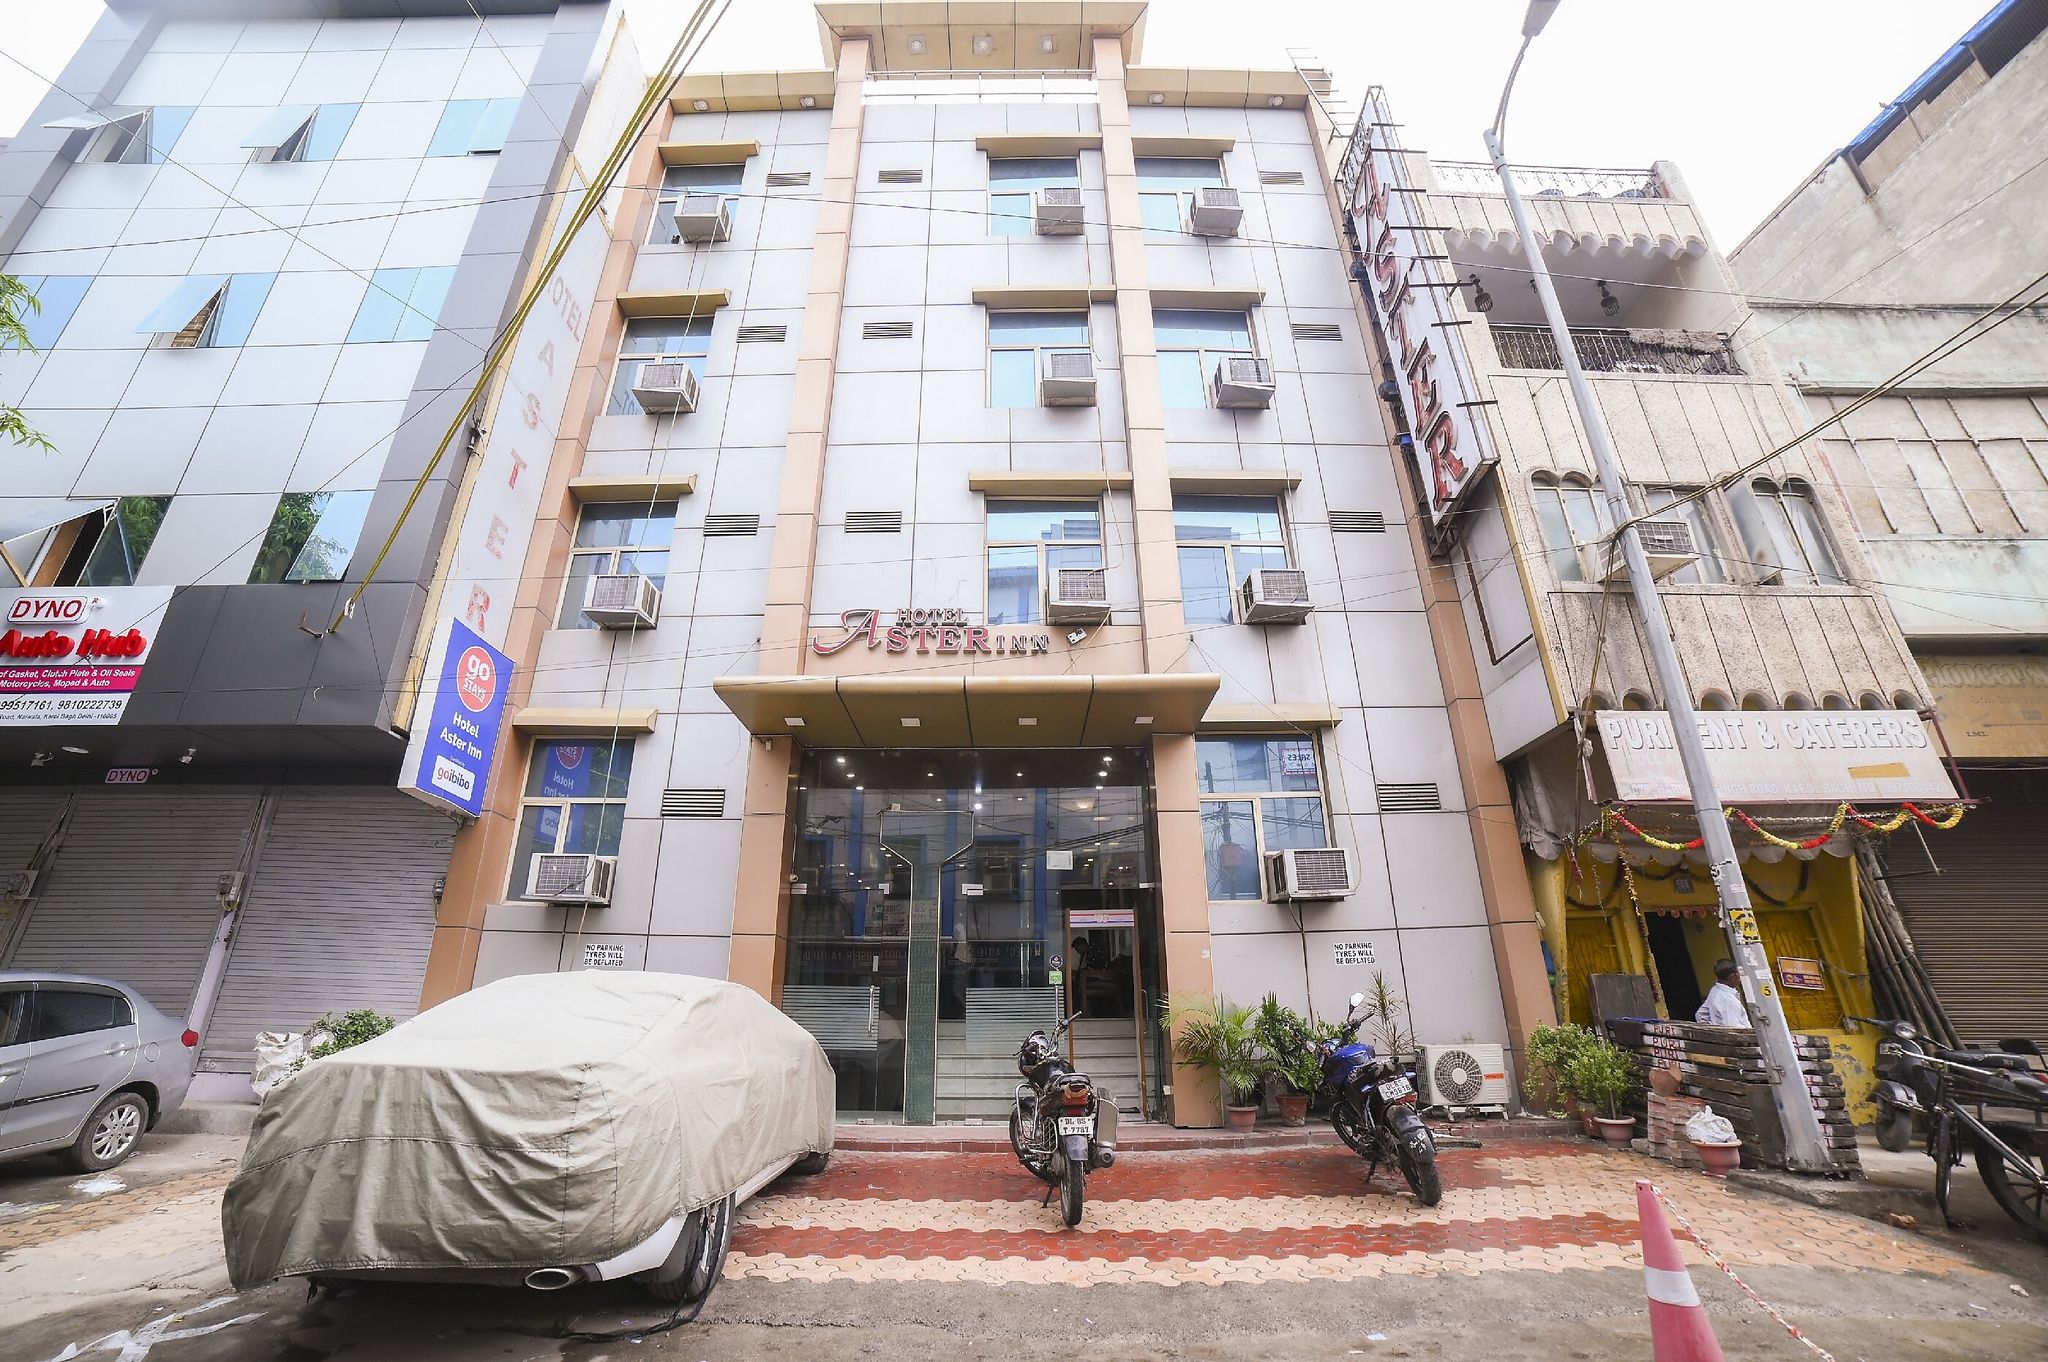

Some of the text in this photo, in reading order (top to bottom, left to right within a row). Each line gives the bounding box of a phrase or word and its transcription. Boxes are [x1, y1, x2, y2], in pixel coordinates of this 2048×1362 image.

[548, 274, 582, 343] OTEL
[11, 599, 82, 619] DYNO
[896, 608, 968, 626] HOTEL
[812, 608, 1049, 654] ASTER INN
[76, 628, 148, 657] Hub
[42, 669, 68, 677] Clutch
[69, 669, 90, 677] Plate
[91, 669, 98, 677] &
[100, 669, 111, 677] Oil
[112, 669, 136, 677] Seals
[467, 654, 490, 681] go
[82, 679, 88, 687] &
[89, 679, 111, 687] Auto
[463, 678, 487, 701] STAYS
[57, 700, 123, 710] 9810222739
[453, 711, 480, 739] Hotel
[1603, 715, 1927, 750] PURI ENT & CATERERS
[440, 726, 482, 760] Aster Inn
[107, 770, 147, 782] DYNO
[437, 766, 470, 790] goibibo
[585, 951, 606, 959] TYRES
[1345, 942, 1372, 950] PARKING
[593, 958, 623, 966] DEFLATED
[1763, 985, 1771, 997] 5
